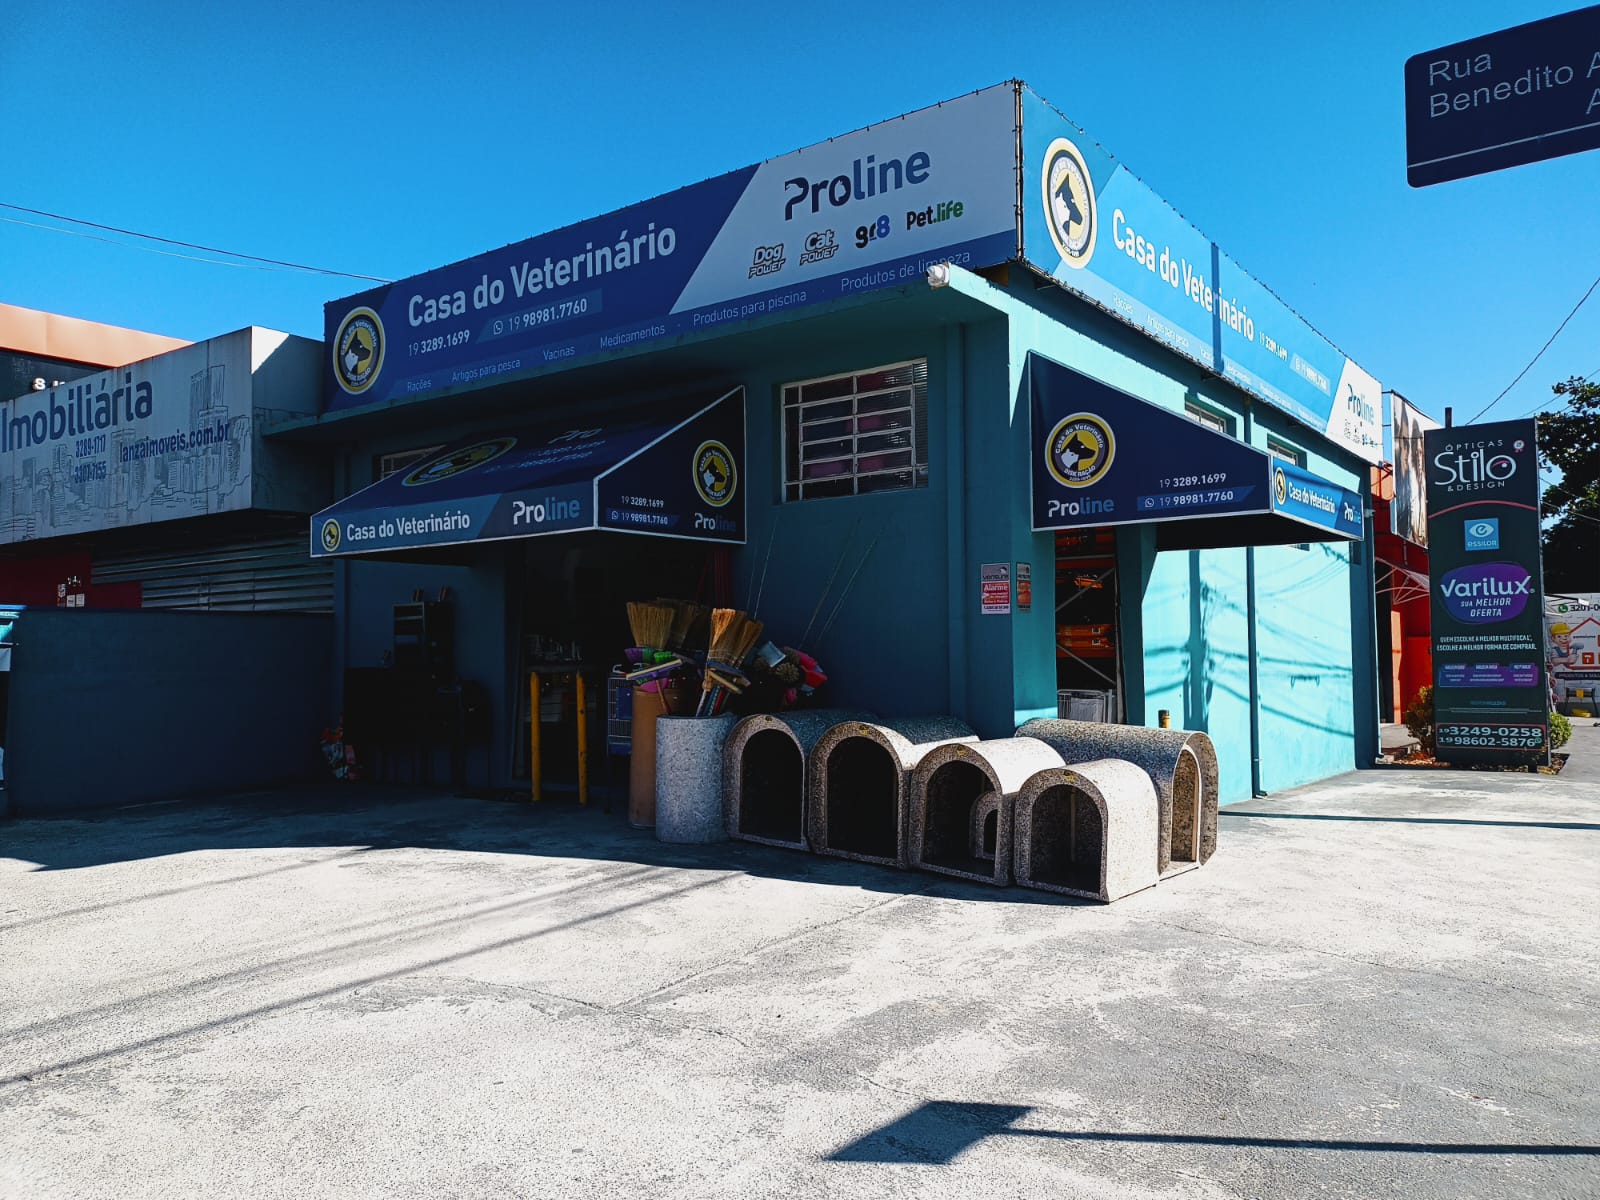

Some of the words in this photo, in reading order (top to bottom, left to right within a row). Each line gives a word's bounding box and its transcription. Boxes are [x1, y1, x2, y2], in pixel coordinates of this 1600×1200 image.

[1429, 53, 1493, 87] Rua
[1429, 65, 1574, 118] Benedito
[784, 151, 931, 221] Proline
[804, 229, 835, 251] Cat
[855, 215, 891, 249] gr8
[753, 243, 785, 266] Dog
[408, 289, 467, 328] Casa
[473, 275, 505, 309] do
[510, 222, 676, 298] Veterinário
[841, 268, 896, 291] Produtos
[899, 263, 914, 278] de
[1112, 208, 1156, 273] Casa
[1159, 246, 1180, 289] do
[1181, 258, 1254, 342] Veterinário
[508, 316, 520, 332] 19
[523, 298, 588, 328] 98981.7760
[693, 305, 739, 327] Produtos
[741, 300, 766, 317] para
[768, 290, 808, 312] piscina
[408, 342, 419, 357] 19
[420, 330, 471, 353] 3289.1699
[600, 323, 666, 349] Medicamentos
[543, 345, 576, 361] Vacinas
[452, 370, 479, 384] Artigos
[479, 365, 497, 379] para
[498, 358, 521, 375] pesca
[407, 378, 433, 393] Rações
[1, 371, 153, 453] Imobiliária
[1434, 448, 1517, 486] Stilo
[1159, 478, 1171, 488] 19
[1172, 473, 1227, 488] 3289.1699
[1456, 481, 1505, 491] DESIGN
[621, 496, 630, 504] 19
[630, 496, 665, 508] 3289.1699
[1048, 496, 1115, 518] Proline
[1159, 496, 1171, 507] 19
[1173, 491, 1234, 506] 98981.7760
[1288, 481, 1302, 502] Casa
[1302, 487, 1310, 504] do
[1309, 489, 1336, 514] Veterinário
[512, 499, 580, 525] Proline
[621, 512, 630, 521] 19
[630, 513, 669, 525] 98981.7760
[346, 523, 376, 542] Casa
[378, 519, 395, 538] do
[396, 510, 471, 536] Veterinário
[1470, 608, 1502, 617] OFERTA
[1475, 597, 1512, 607] MELHOR
[1449, 726, 1542, 737] 3249-0258
[1454, 736, 1536, 747] 98602-5876
